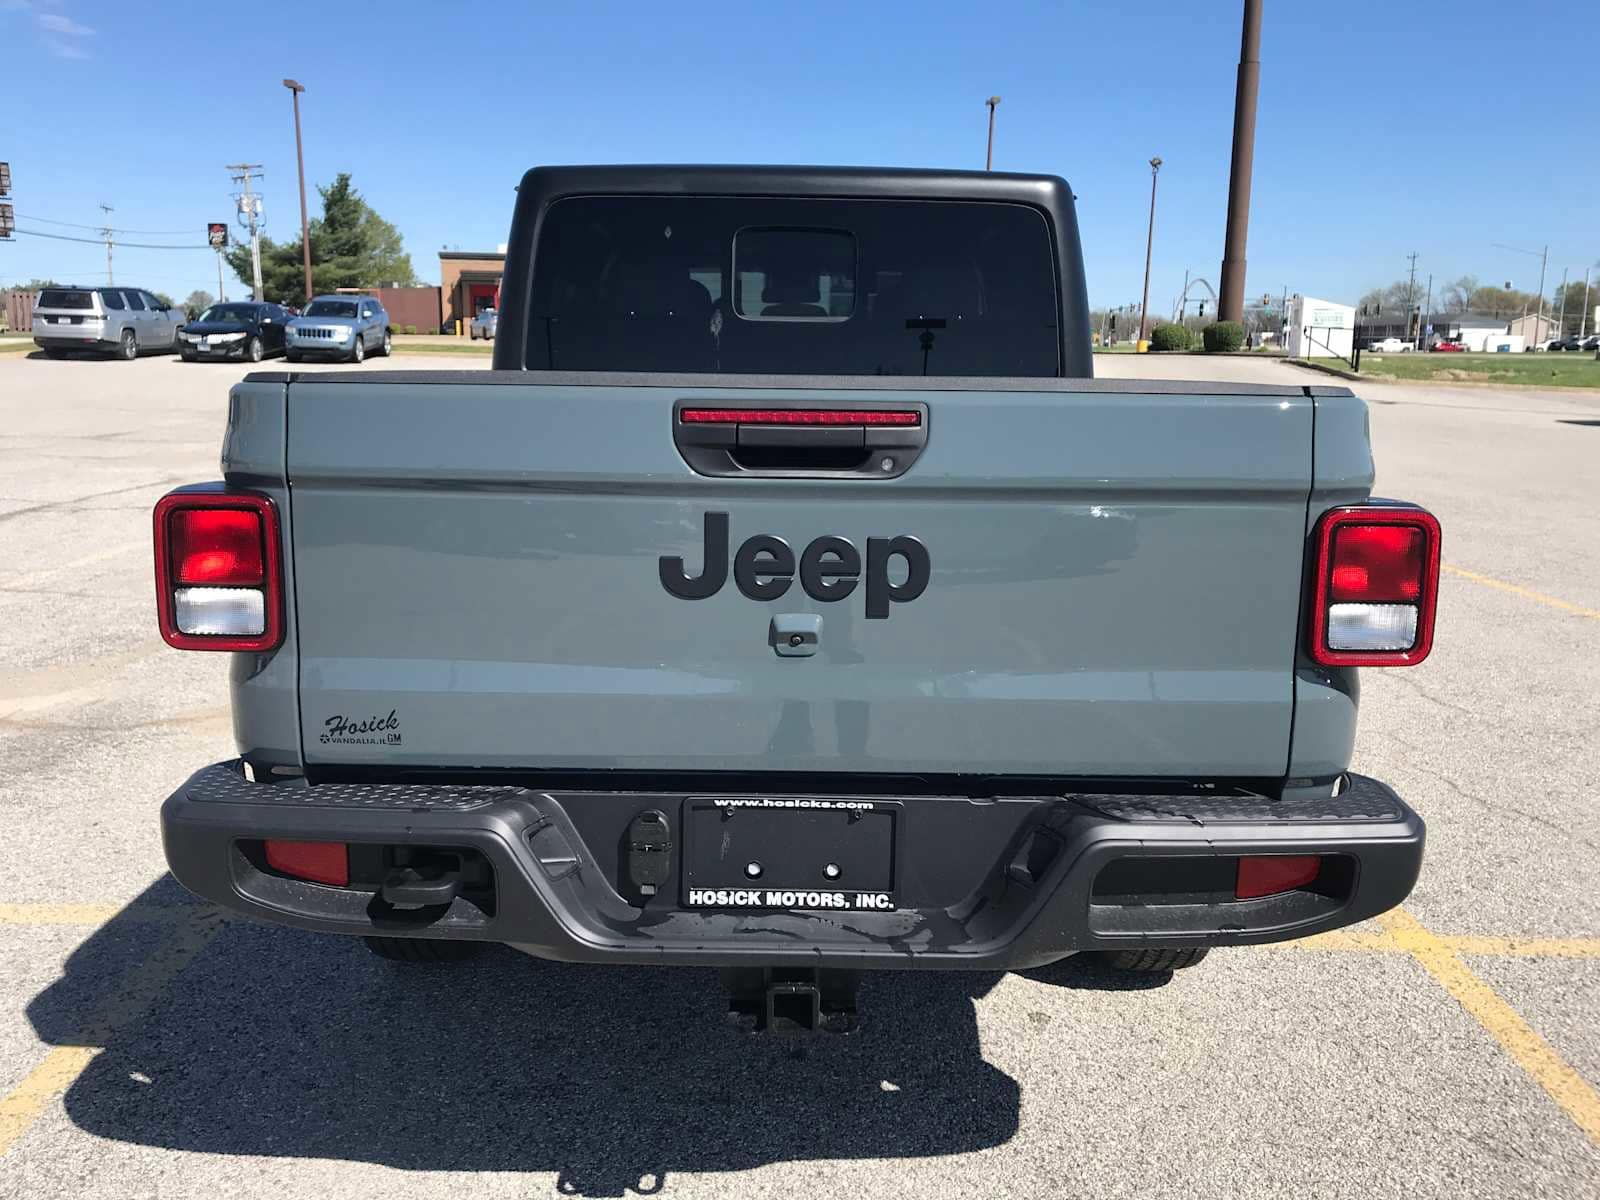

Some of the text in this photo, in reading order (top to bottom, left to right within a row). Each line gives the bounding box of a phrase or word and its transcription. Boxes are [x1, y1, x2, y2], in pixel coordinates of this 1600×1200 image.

[658, 511, 931, 619] Jeep
[325, 709, 399, 736] Hosick
[714, 798, 874, 810] www.hosicks.com
[766, 892, 850, 908] MOTORS,
[856, 894, 894, 908] INC.
